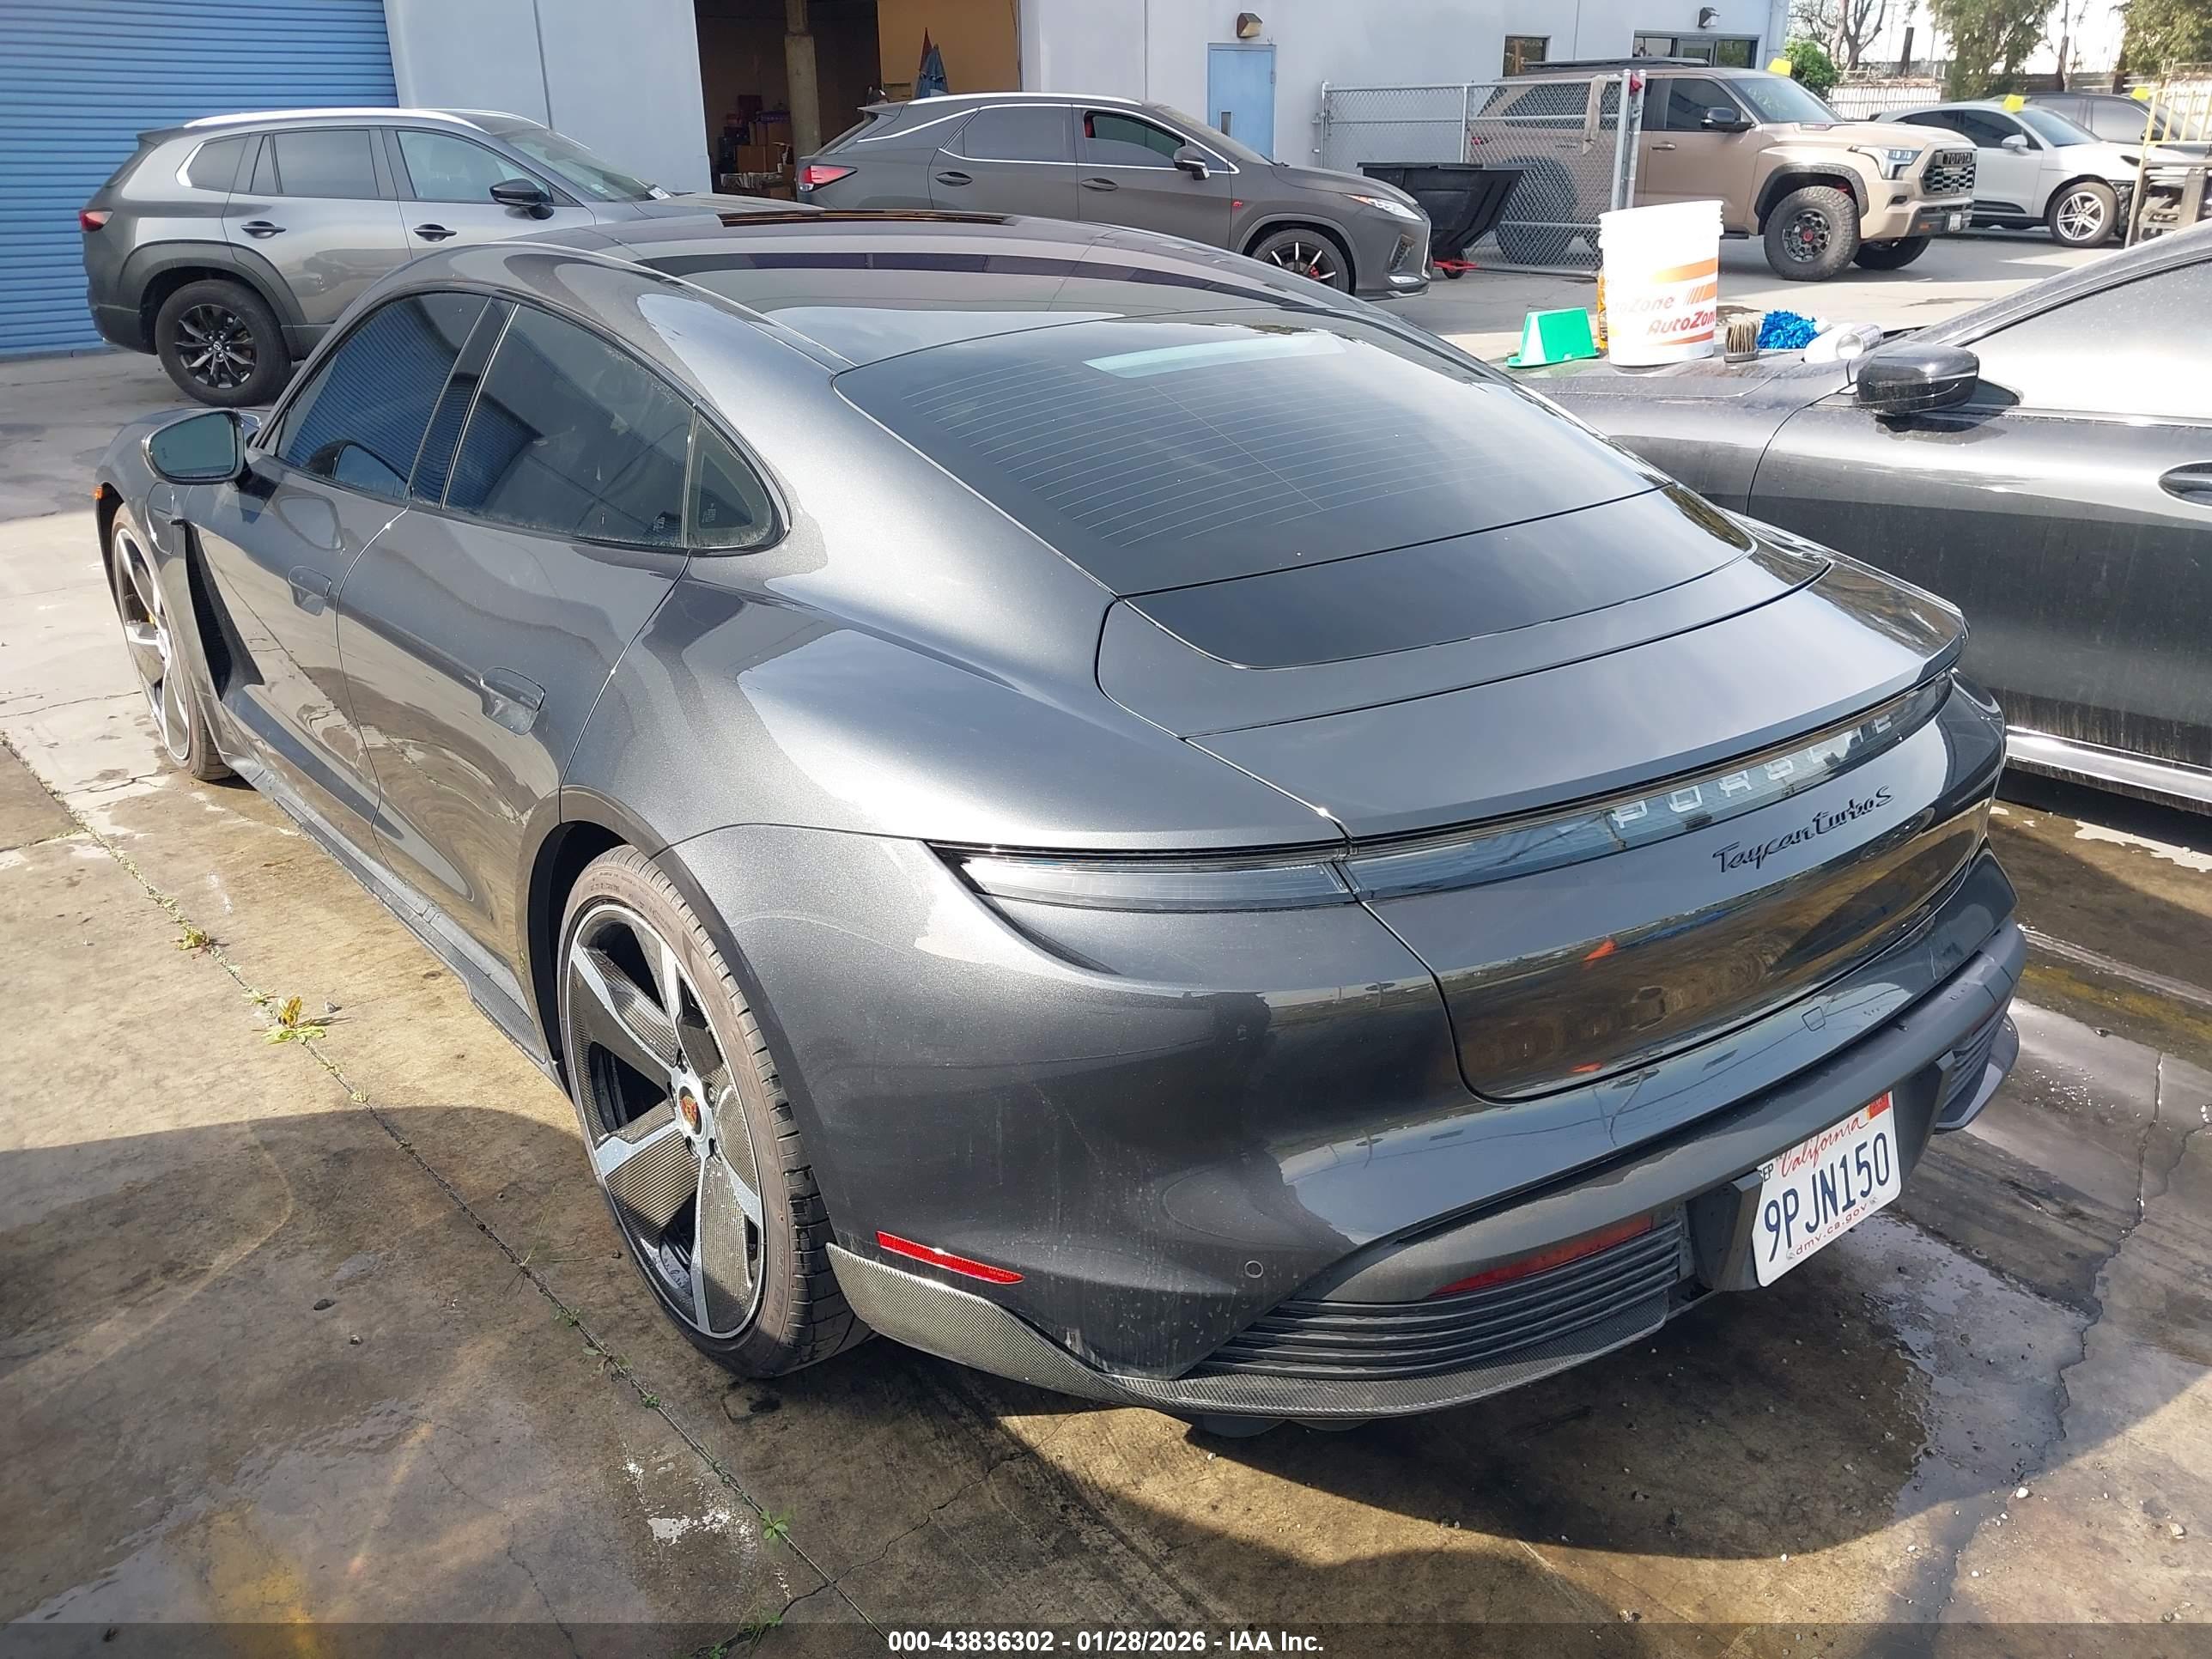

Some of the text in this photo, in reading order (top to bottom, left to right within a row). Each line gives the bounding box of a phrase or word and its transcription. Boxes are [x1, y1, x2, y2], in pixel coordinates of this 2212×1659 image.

[1947, 152, 1972, 165] TOYOTA
[1712, 828, 1815, 873] Taycan
[1780, 1115, 1869, 1177] California
[1796, 1202, 1867, 1255] dmv.ca.gov
